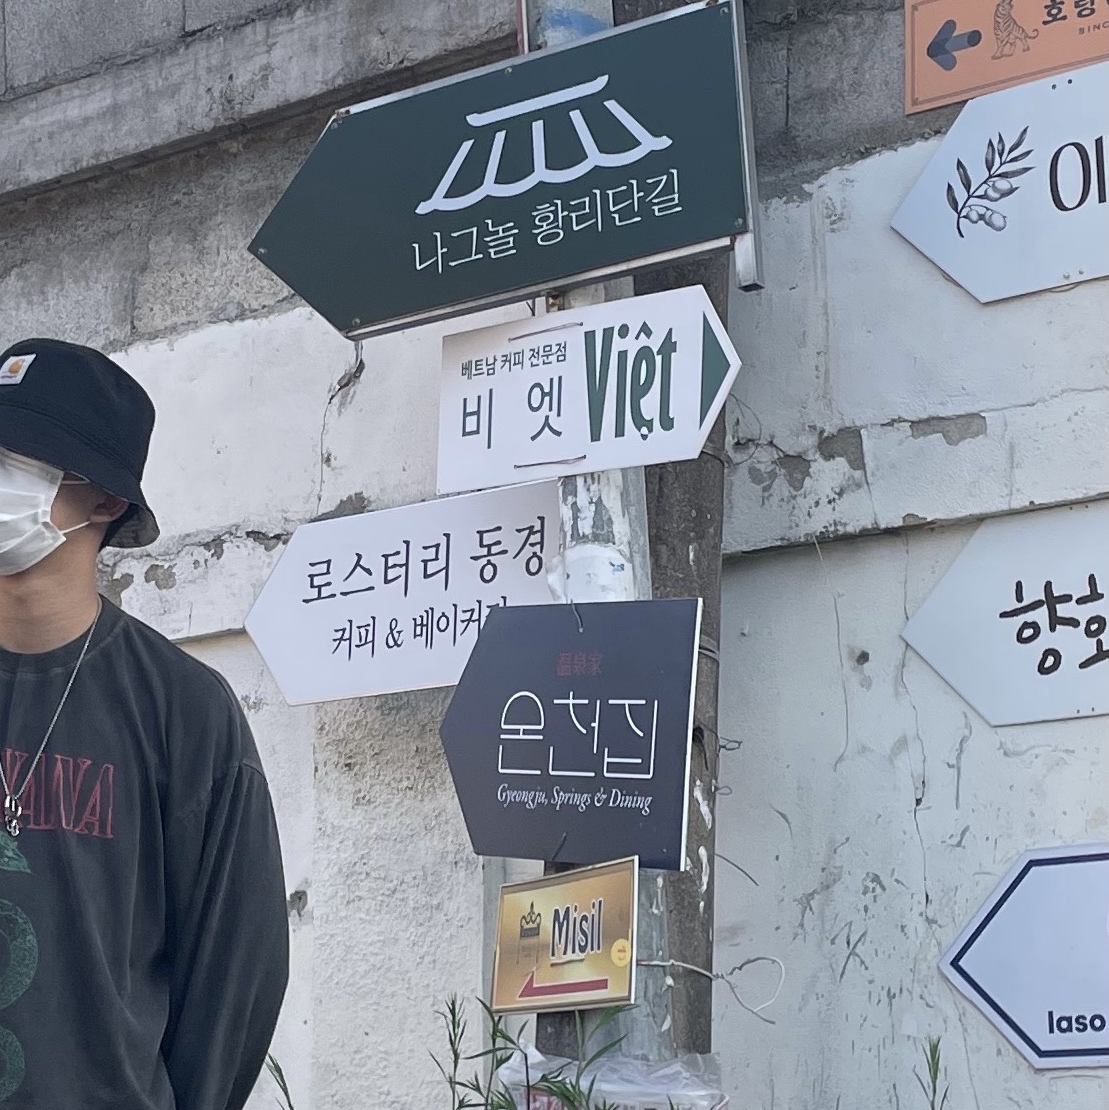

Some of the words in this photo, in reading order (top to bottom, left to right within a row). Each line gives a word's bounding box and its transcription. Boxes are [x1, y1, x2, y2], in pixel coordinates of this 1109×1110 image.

[411, 217, 521, 274] 나그놀
[531, 168, 685, 248] 황리단길
[461, 354, 498, 380] 베트남
[500, 349, 525, 373] 커피
[528, 340, 567, 368] 전문점
[302, 532, 451, 604] 로스터리
[470, 515, 546, 577] 동경
[331, 616, 377, 661] 커피
[385, 617, 404, 650] &
[412, 596, 507, 650] 베이커
[497, 783, 548, 809] Gyeongju,
[551, 785, 592, 812] Springs
[594, 787, 607, 807] &
[608, 788, 653, 816] Dining
[550, 897, 603, 958] Misil
